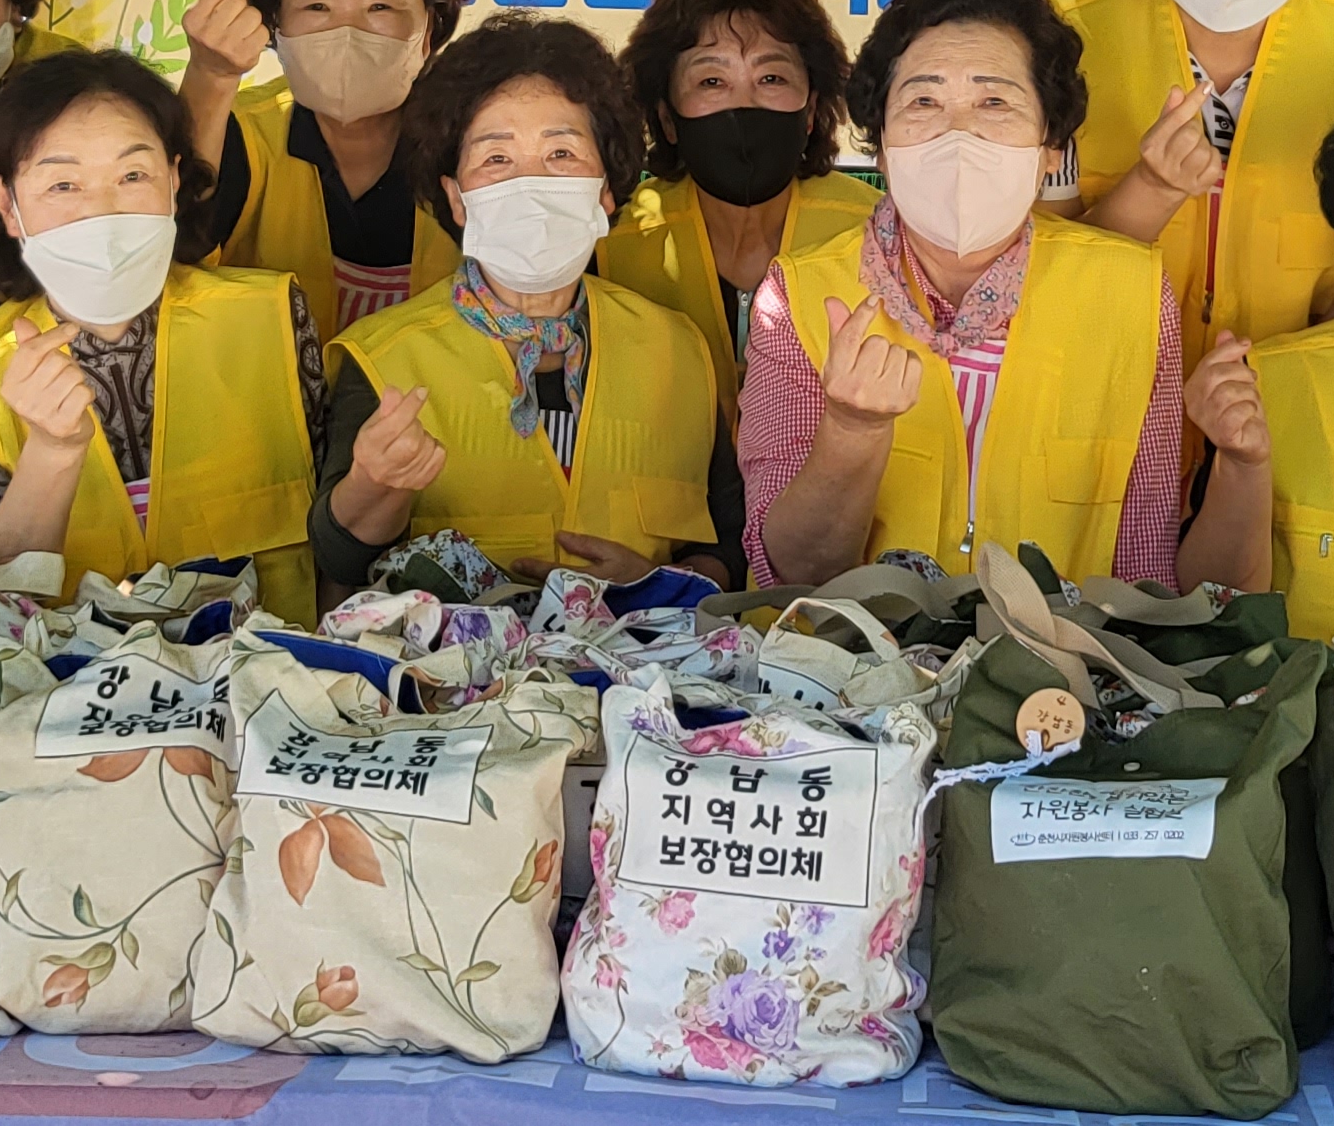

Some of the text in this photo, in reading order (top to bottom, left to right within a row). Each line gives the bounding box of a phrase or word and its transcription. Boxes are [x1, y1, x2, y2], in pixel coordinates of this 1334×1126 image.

[265, 754, 430, 797] 보장협의체
[1020, 799, 1114, 821] 자원봉사
[659, 834, 824, 882] 보장협의체
